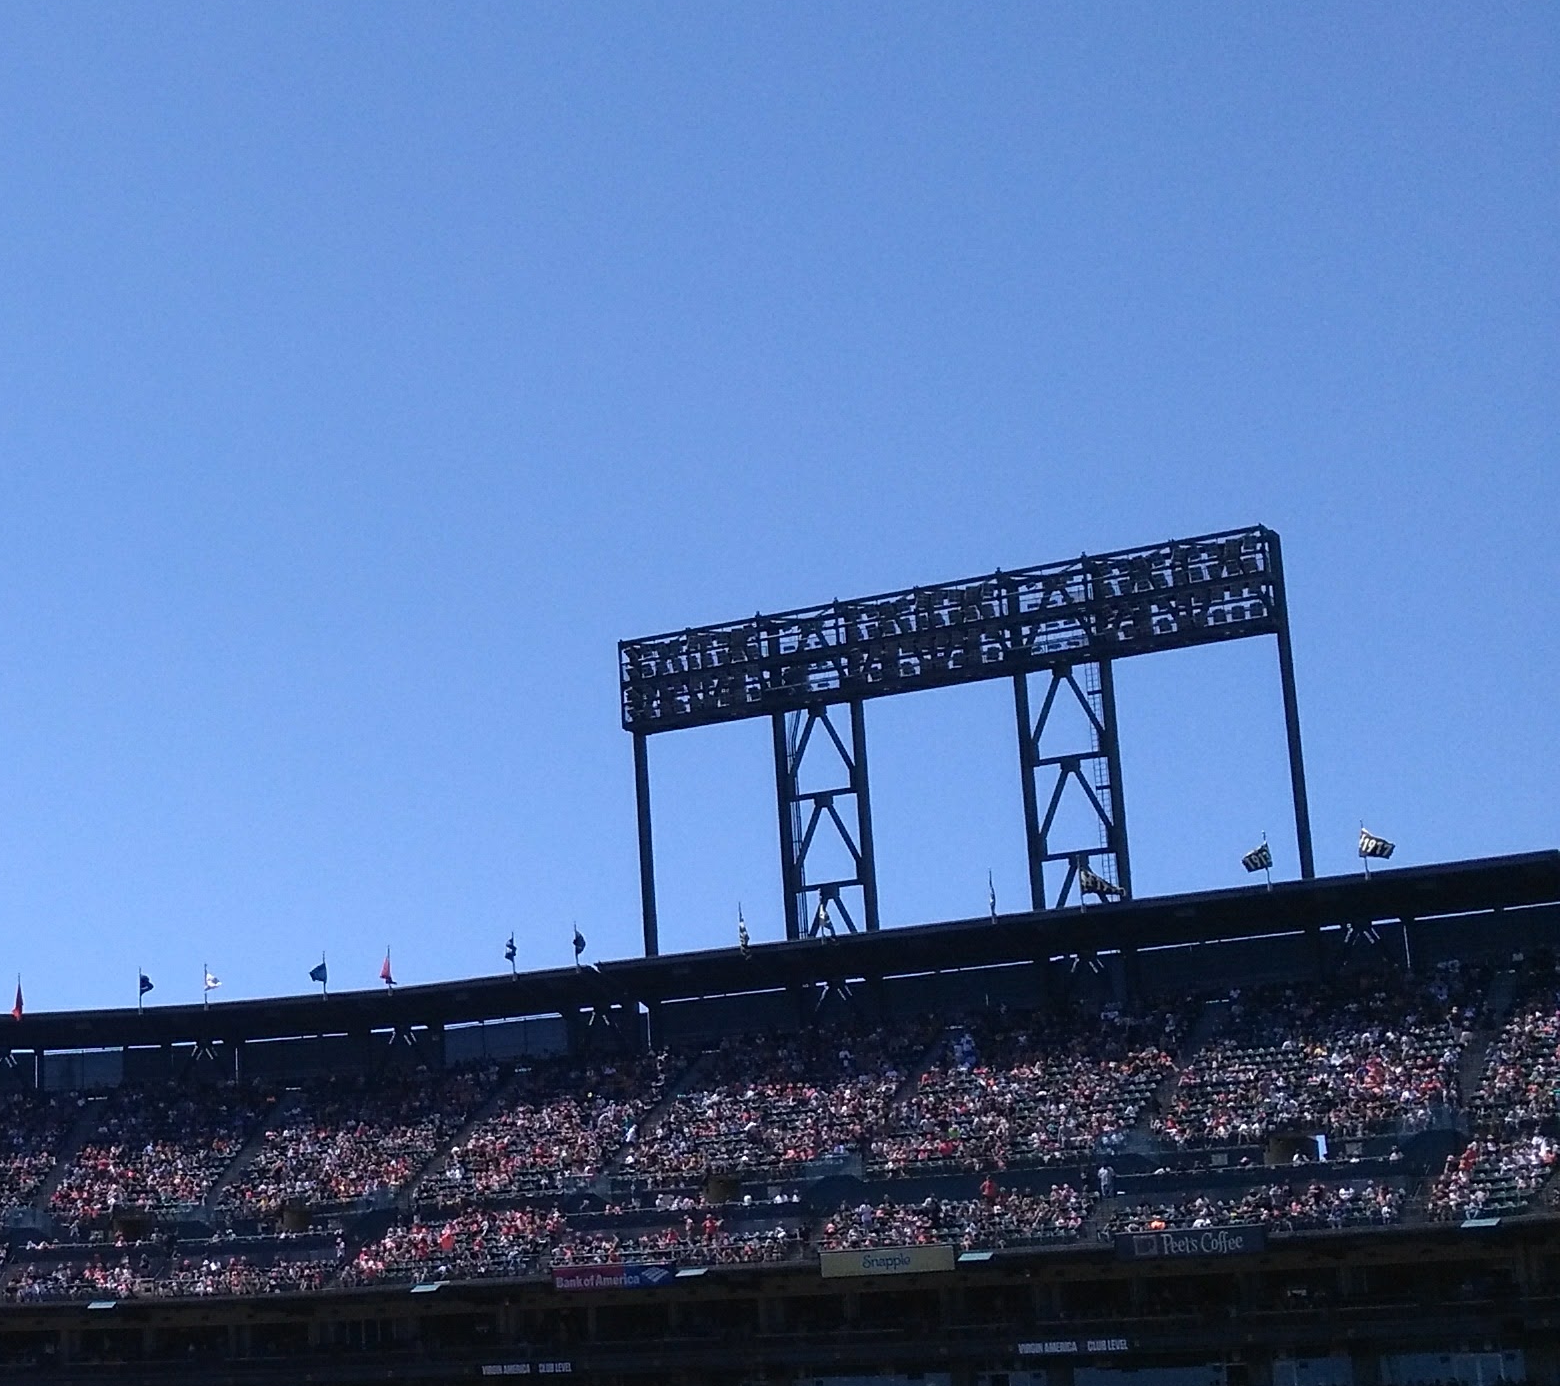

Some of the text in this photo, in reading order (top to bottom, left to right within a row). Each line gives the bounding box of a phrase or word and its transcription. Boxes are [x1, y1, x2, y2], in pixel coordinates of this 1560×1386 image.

[1160, 1231, 1243, 1255] Peet's Coffee
[862, 1253, 911, 1269] Snapple
[555, 1273, 640, 1289] Bank of America
[1107, 1339, 1128, 1350] LEVEL
